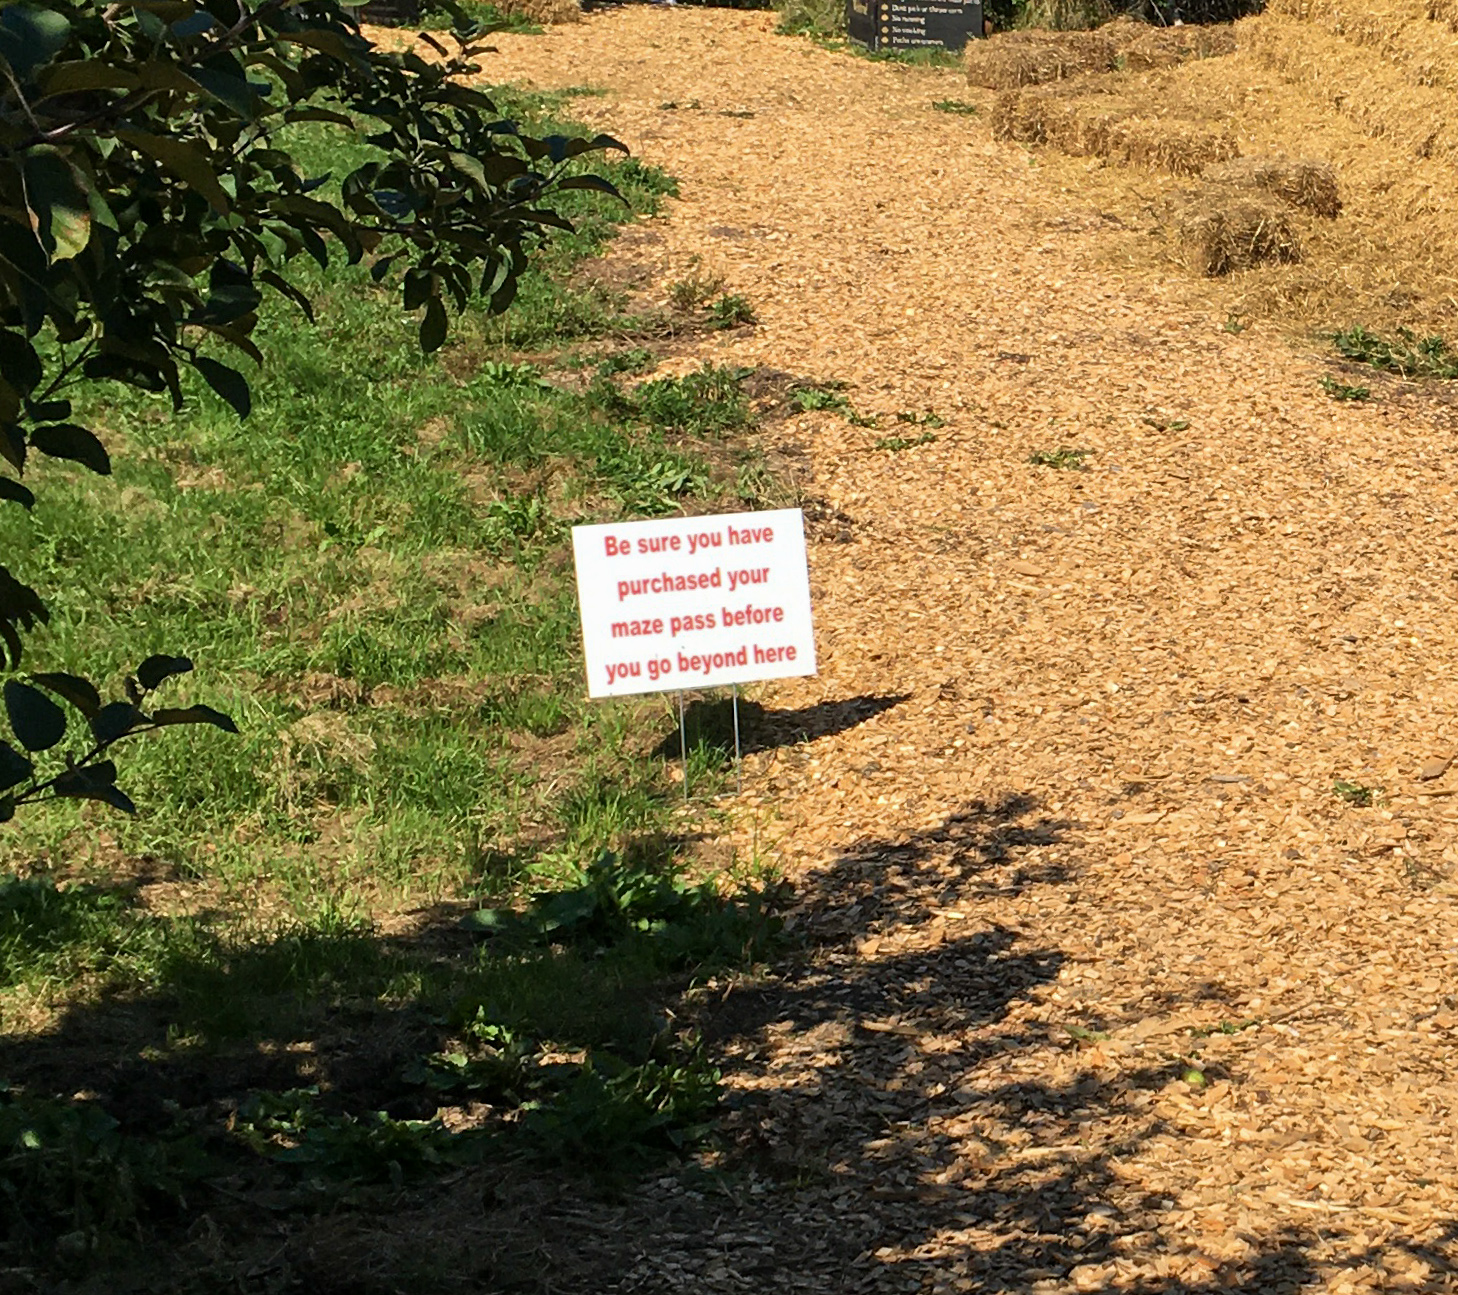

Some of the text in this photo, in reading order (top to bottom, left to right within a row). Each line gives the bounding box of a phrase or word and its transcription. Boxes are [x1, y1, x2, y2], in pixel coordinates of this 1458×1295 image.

[891, 14, 901, 22] No
[604, 525, 773, 556] Be sure you have
[618, 568, 770, 601] purchased your
[612, 604, 784, 637] maze pass before
[606, 644, 797, 684] you go beyond here
